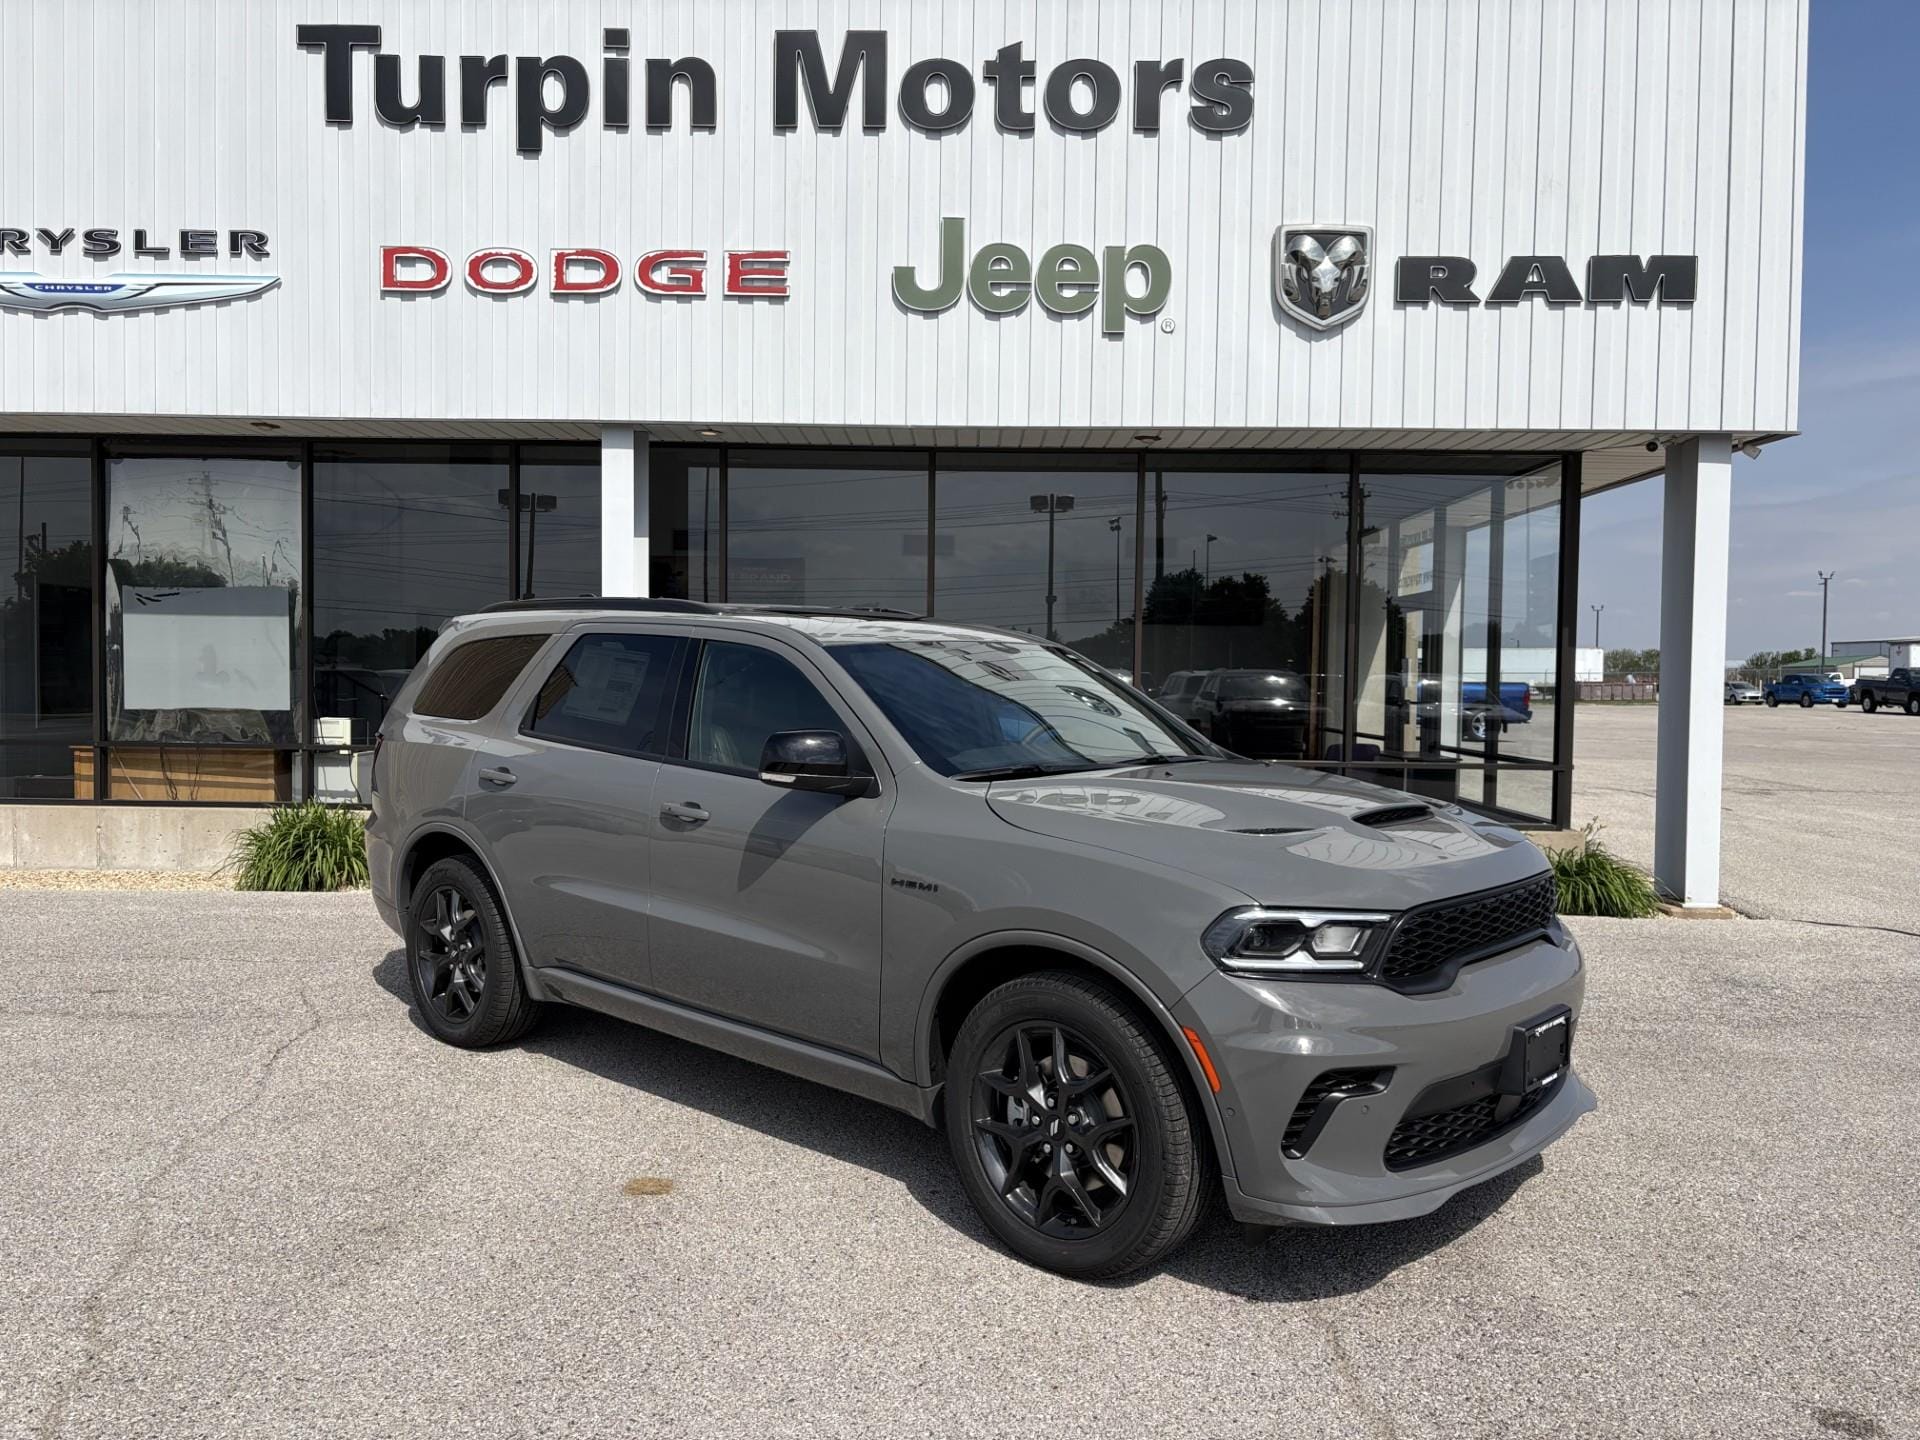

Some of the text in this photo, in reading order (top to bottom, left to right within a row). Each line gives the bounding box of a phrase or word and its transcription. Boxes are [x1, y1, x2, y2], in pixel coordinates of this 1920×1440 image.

[296, 24, 1255, 153] Turpin Motors
[0, 227, 271, 255] RYSLER
[35, 284, 113, 292] CHRYSLER
[379, 245, 792, 298] DODGE
[892, 217, 1172, 334] Jeep
[1394, 254, 1699, 303] RAM
[891, 878, 939, 892] HEMI
